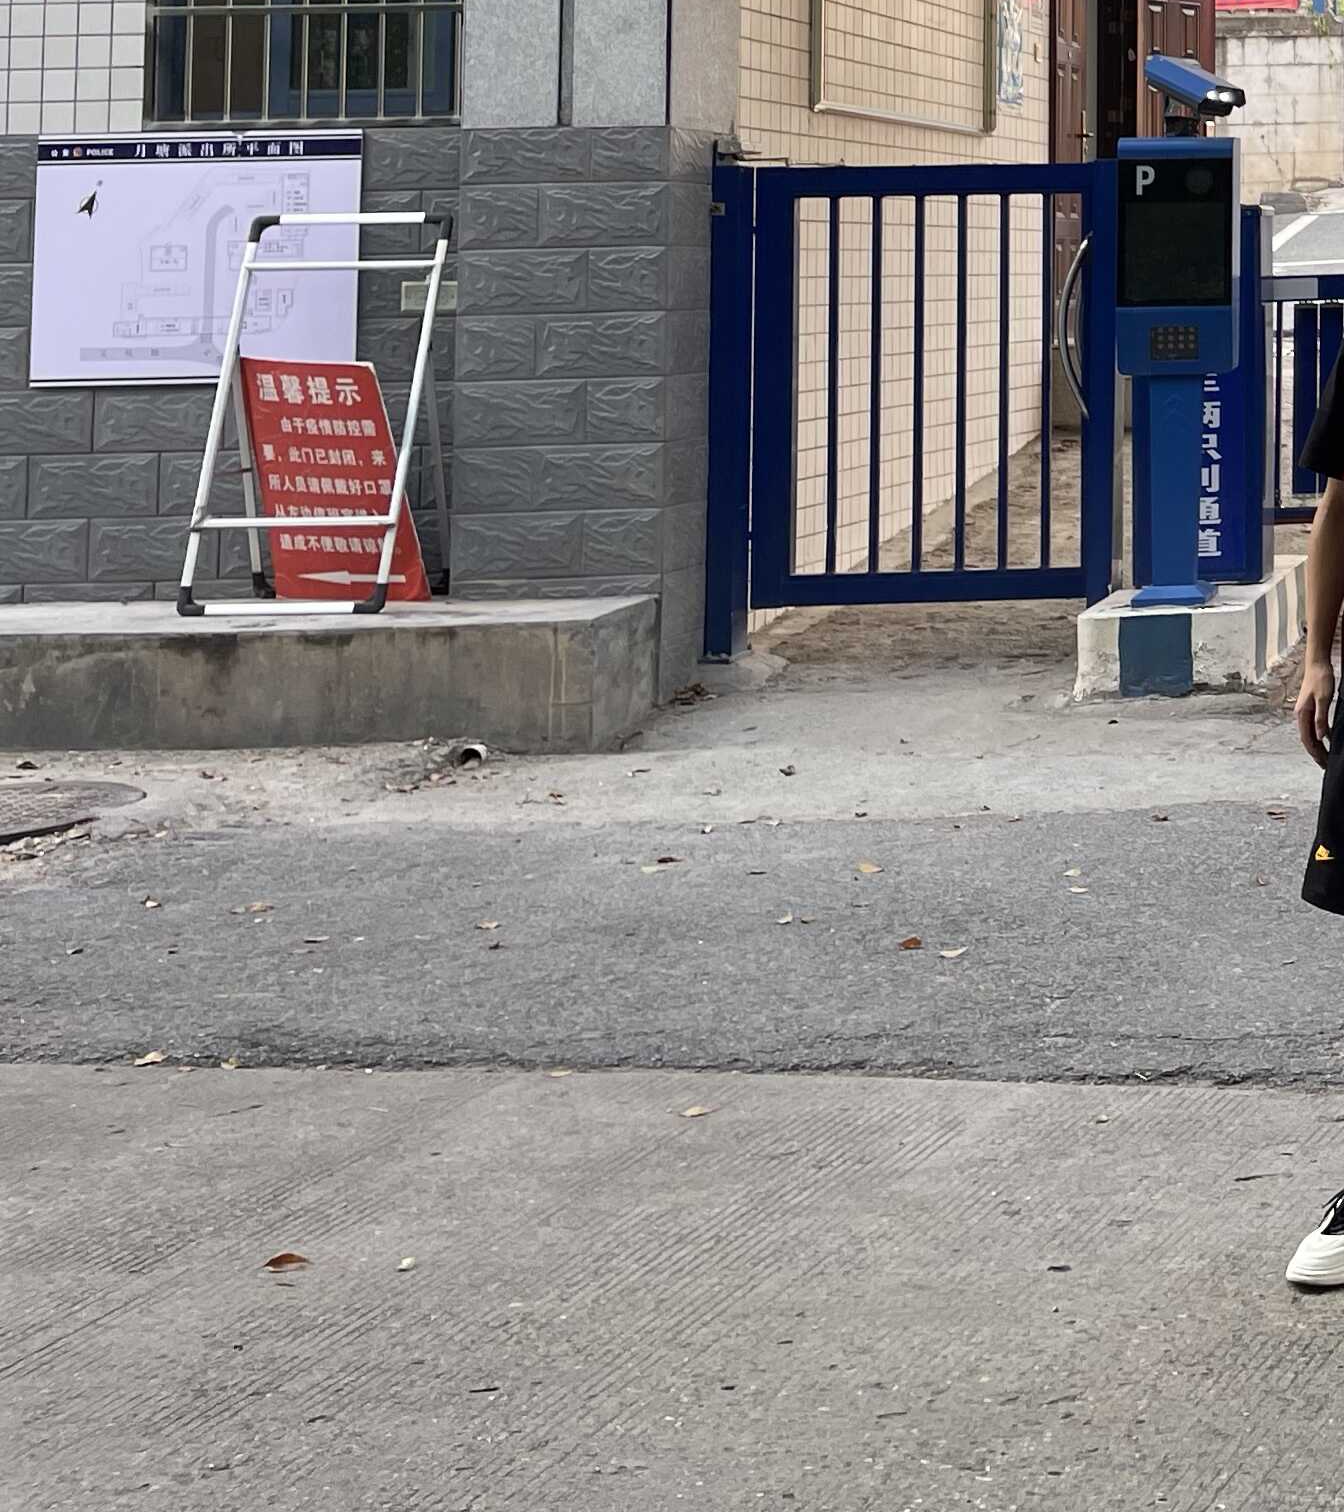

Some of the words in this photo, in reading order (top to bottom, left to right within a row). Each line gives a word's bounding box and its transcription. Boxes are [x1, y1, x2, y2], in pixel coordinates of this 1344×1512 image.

[1135, 165, 1155, 196] P
[256, 373, 361, 406] 温馨提示
